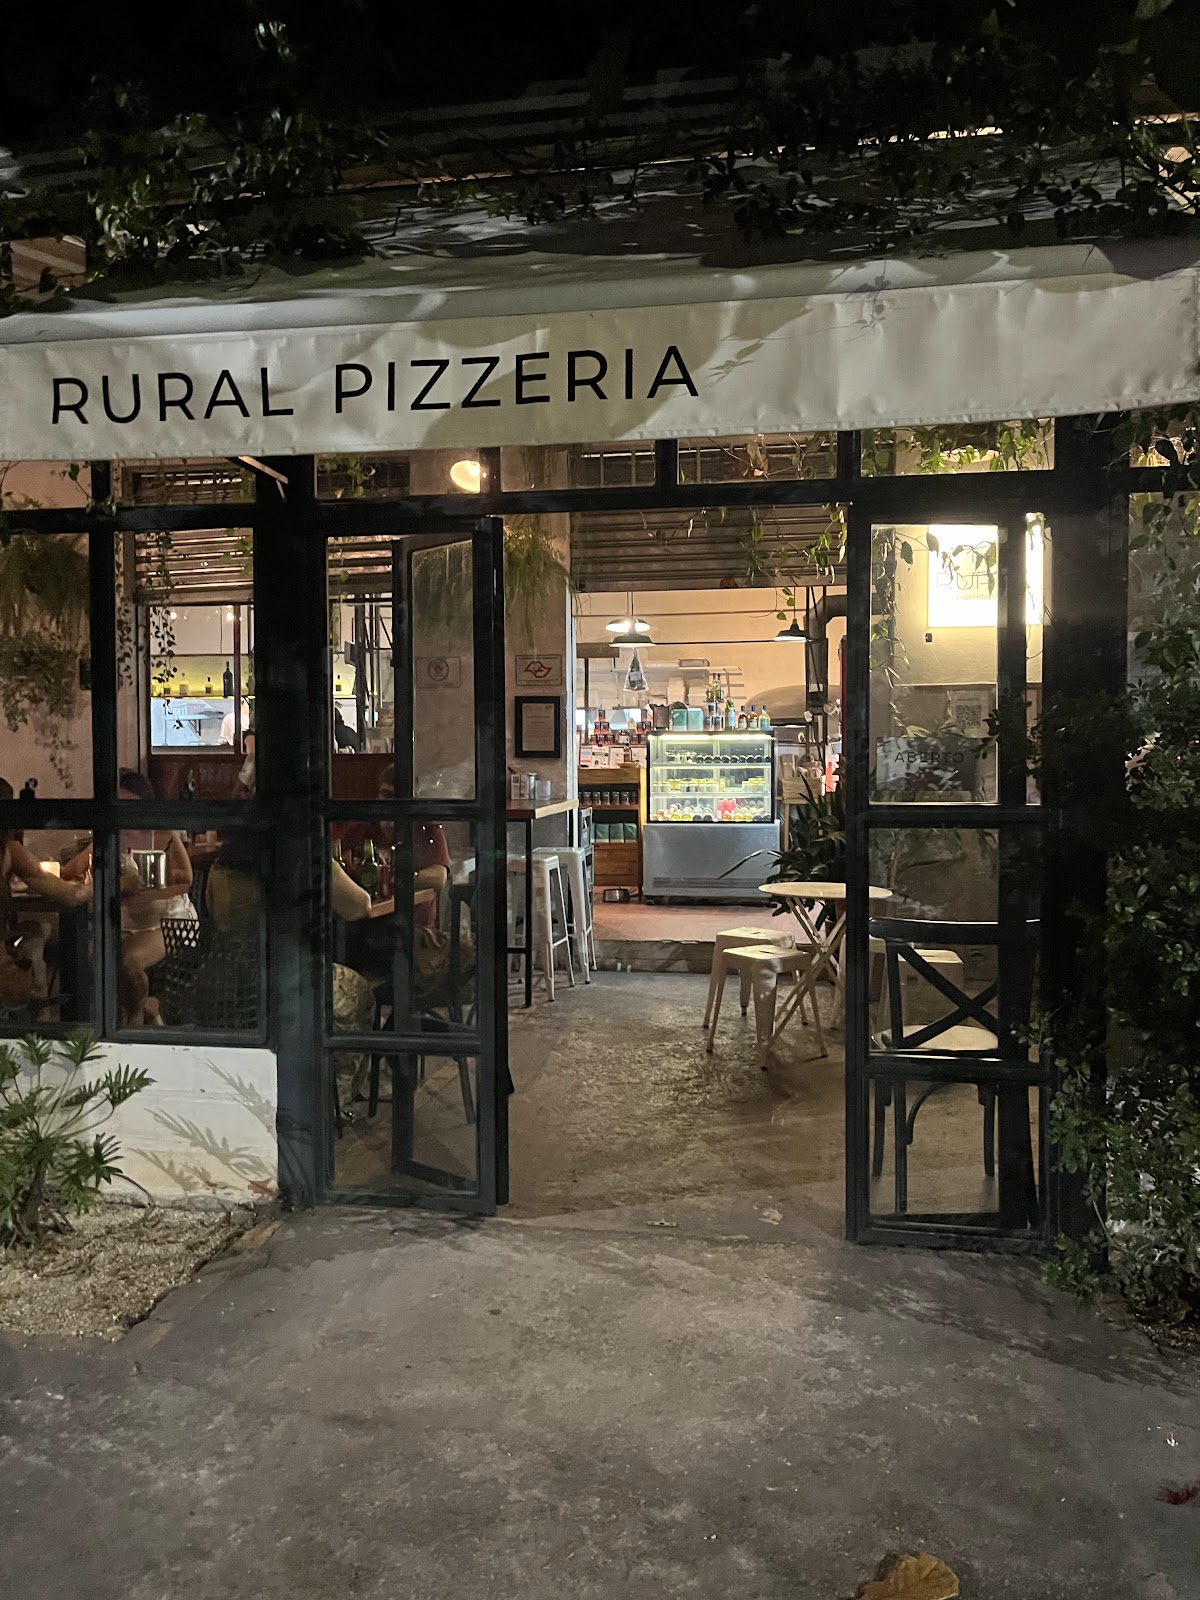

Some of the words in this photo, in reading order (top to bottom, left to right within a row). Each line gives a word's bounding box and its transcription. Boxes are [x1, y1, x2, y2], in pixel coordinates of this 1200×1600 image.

[52, 367, 294, 424] RURAL
[335, 345, 699, 413] PIZZERIA
[894, 751, 965, 763] ABERTO
